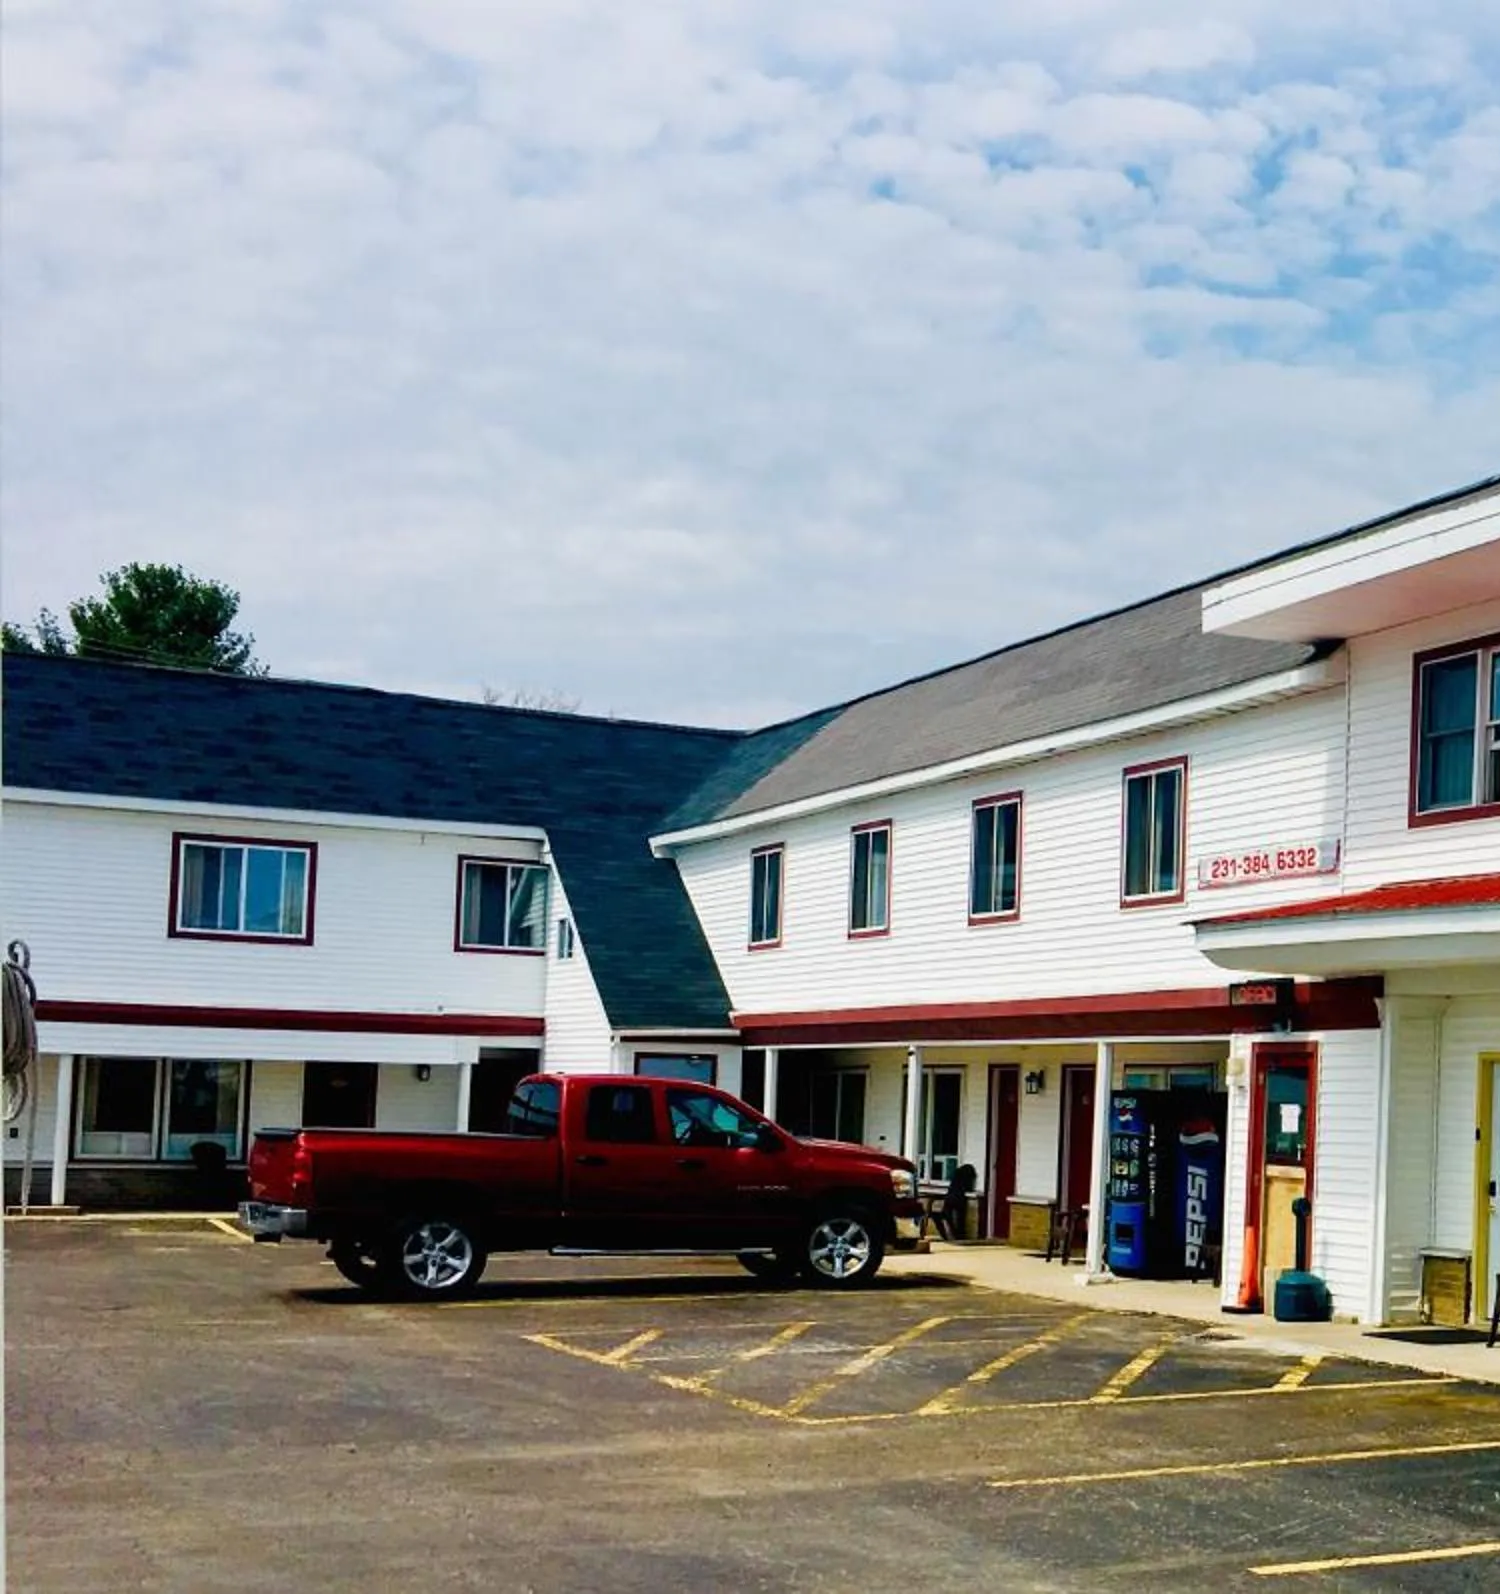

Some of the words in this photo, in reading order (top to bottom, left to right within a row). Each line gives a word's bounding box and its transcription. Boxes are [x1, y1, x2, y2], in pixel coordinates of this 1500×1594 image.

[1211, 854, 1270, 879] 231-384
[1277, 847, 1317, 870] 6332
[1185, 1165, 1209, 1269] PEPSI
